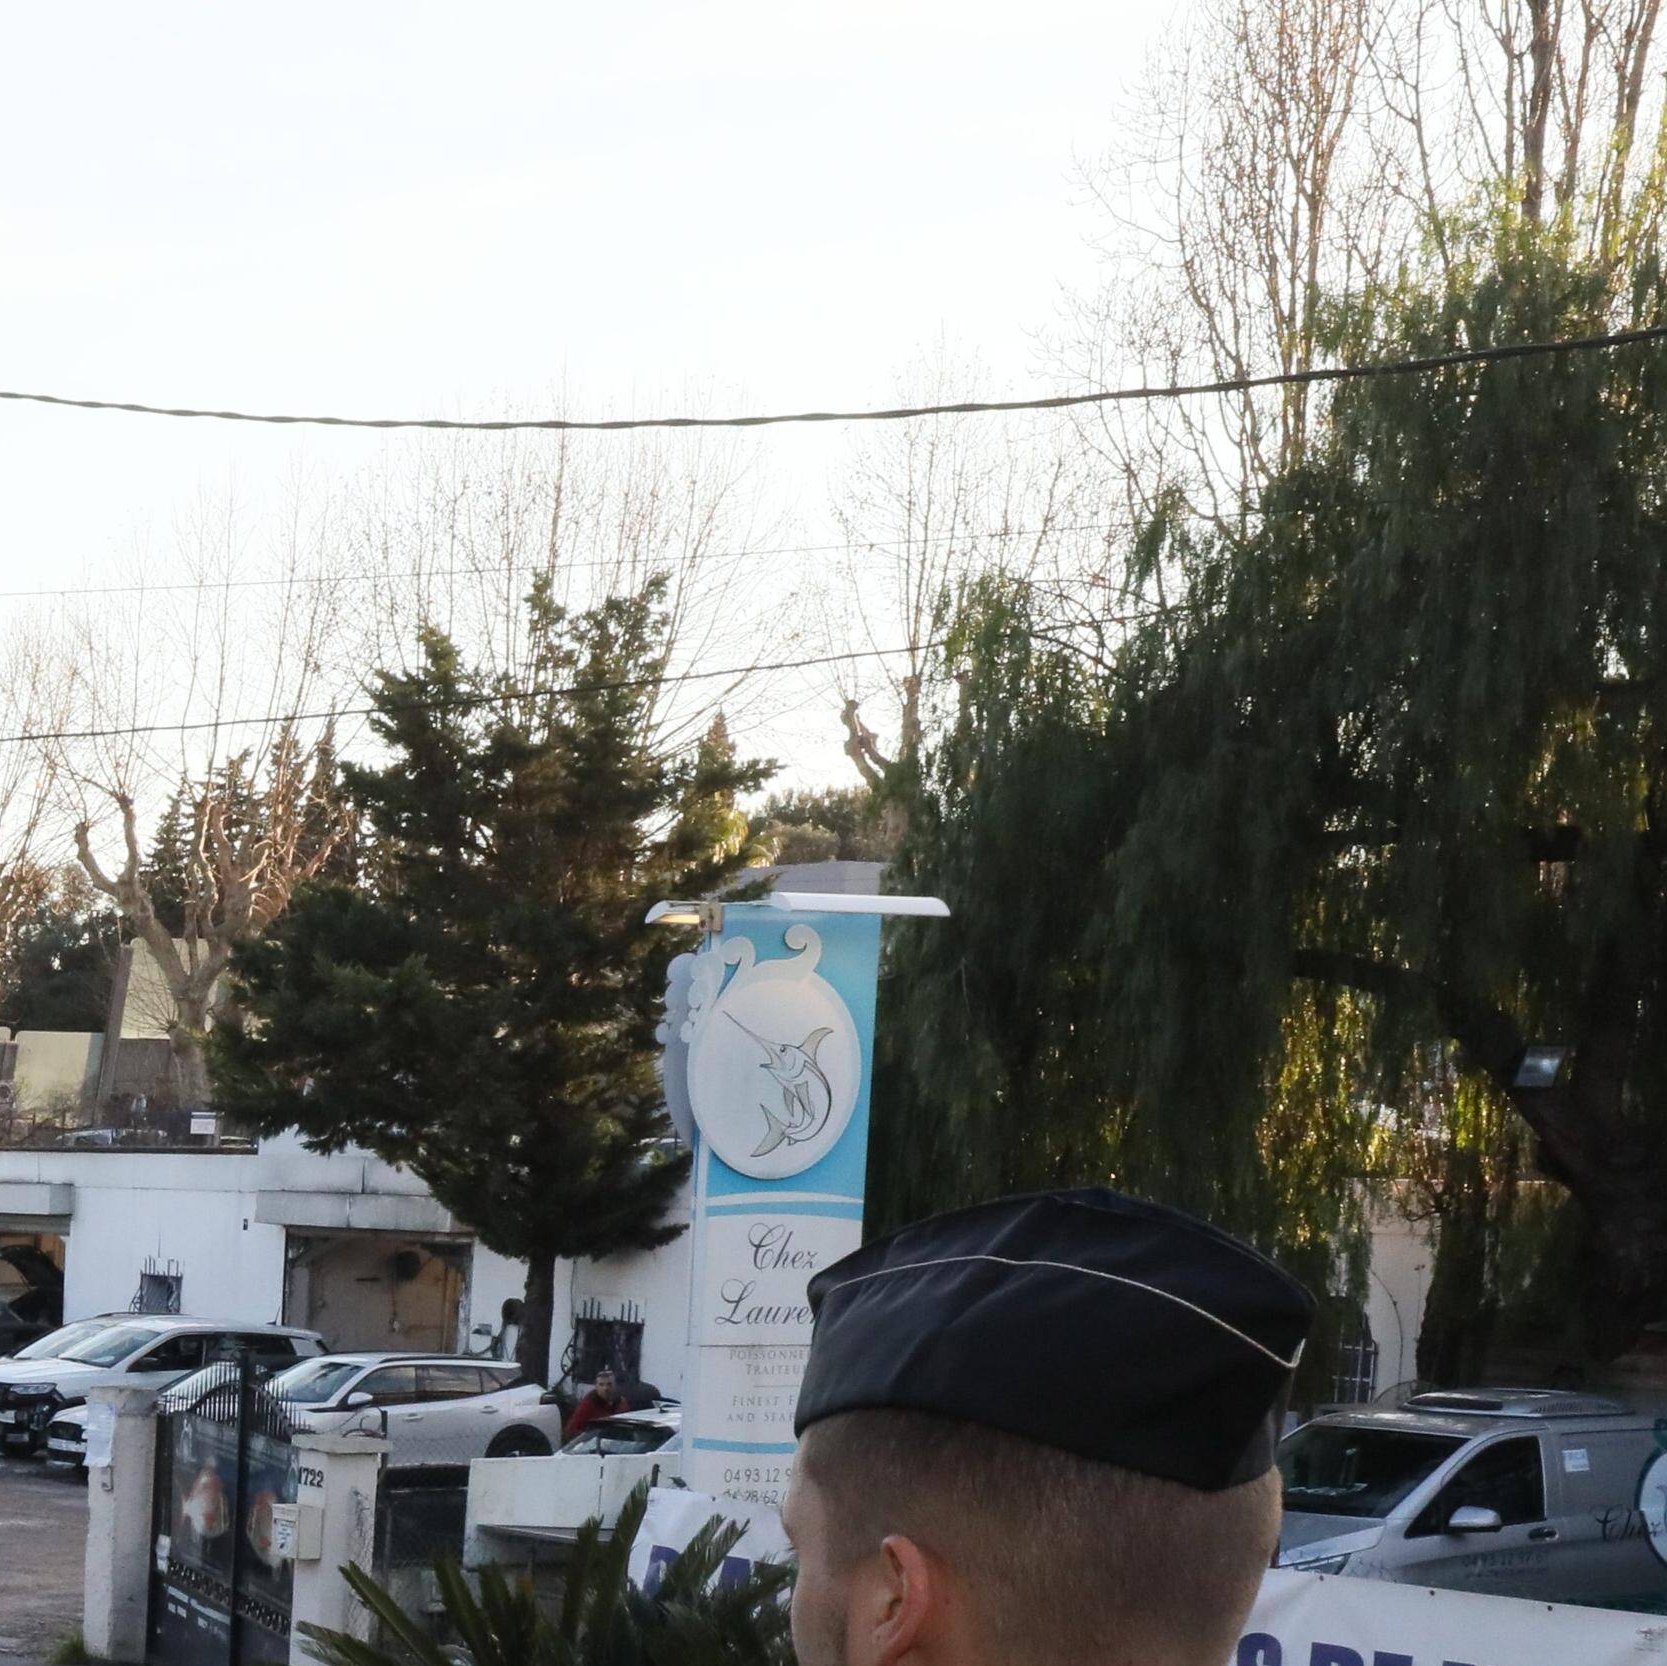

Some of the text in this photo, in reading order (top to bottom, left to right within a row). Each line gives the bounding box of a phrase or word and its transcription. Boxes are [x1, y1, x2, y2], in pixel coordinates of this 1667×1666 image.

[748, 1222, 818, 1271] Chez
[729, 1349, 810, 1361] POISSONNE
[298, 1466, 324, 1488] 1722
[724, 1468, 740, 1483] 04
[745, 1468, 760, 1483] 93
[764, 1468, 779, 1482] 12
